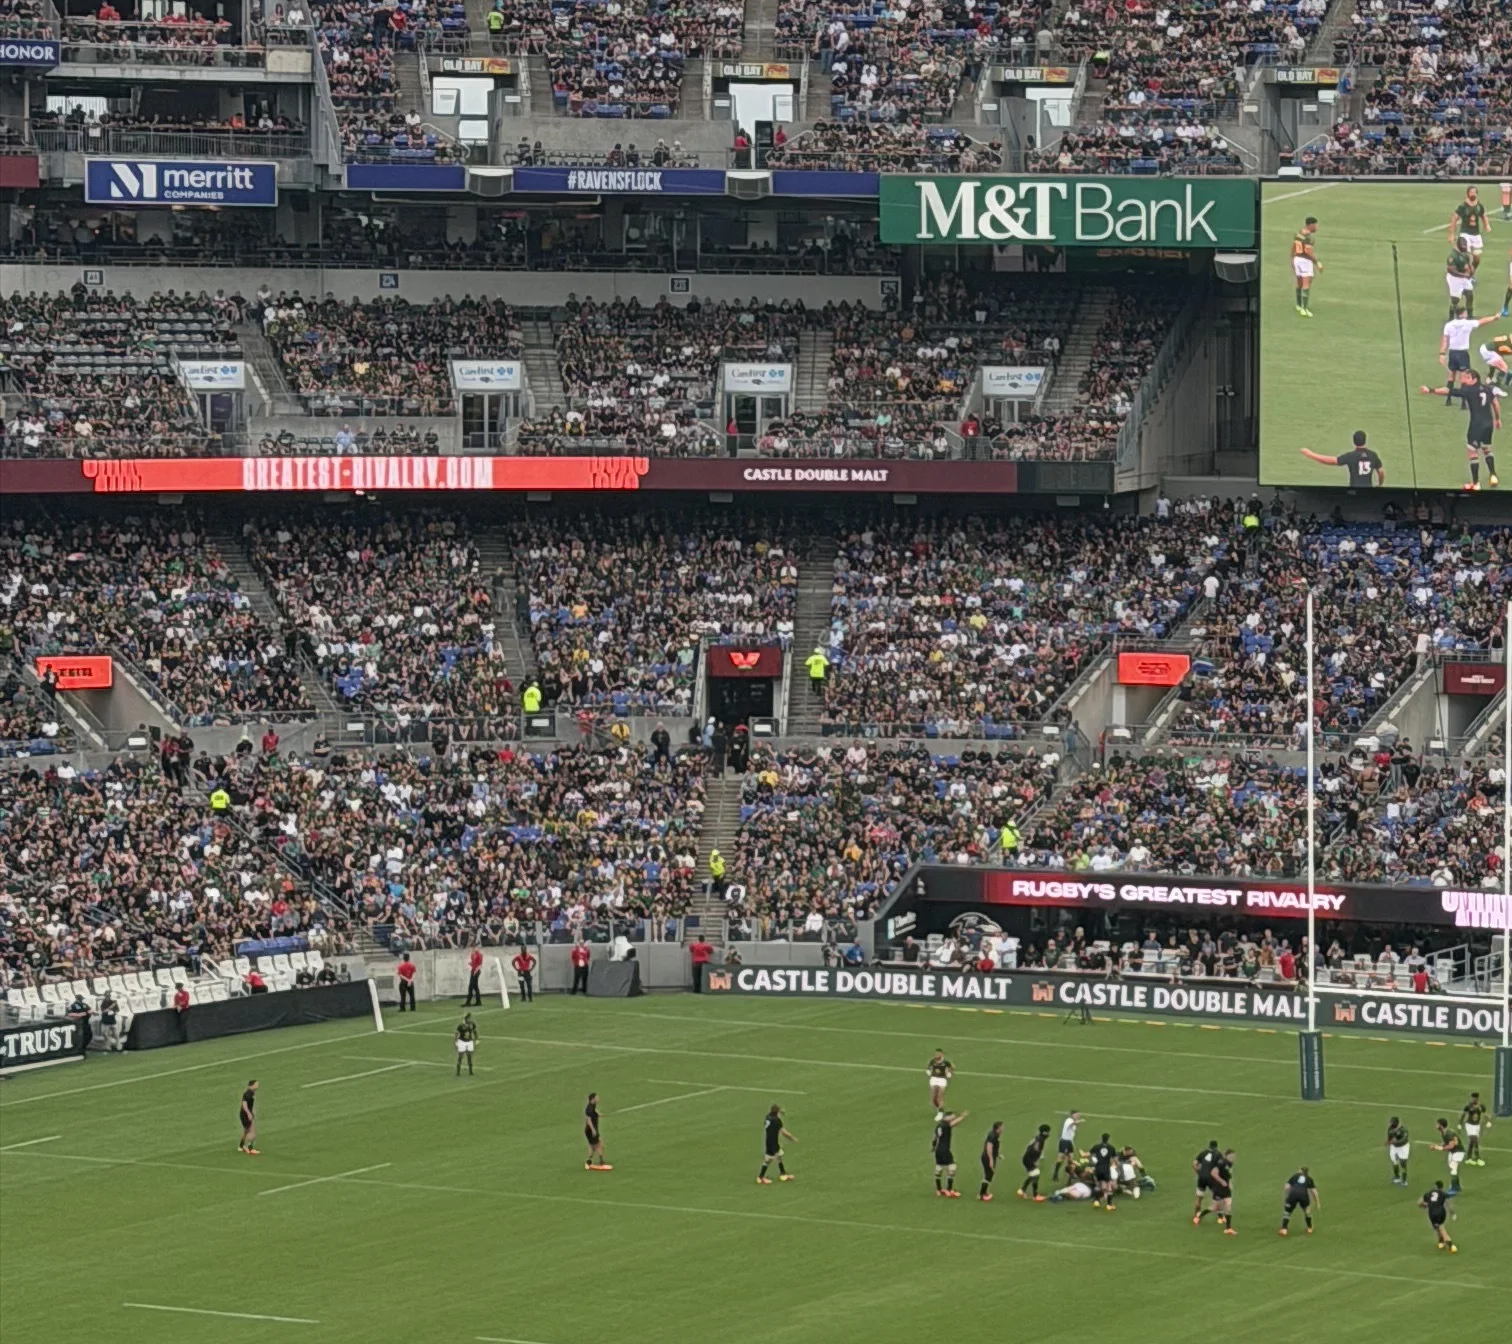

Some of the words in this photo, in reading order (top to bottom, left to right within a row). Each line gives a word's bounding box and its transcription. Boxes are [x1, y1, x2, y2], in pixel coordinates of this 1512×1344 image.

[163, 166, 253, 189] merritt
[567, 171, 662, 191] #RAVENSFLOCK
[164, 191, 224, 199] COMPANIES
[915, 181, 1067, 240] M&T
[1075, 183, 1218, 242] Bank
[243, 456, 493, 490] GREATEST-RIVALRY.COM
[743, 468, 792, 481] CASTLE
[795, 468, 848, 482] DOUBLE
[851, 468, 889, 482] MALT
[1358, 460, 1371, 475] 13
[1012, 880, 1116, 900] RUGBY'S
[1120, 885, 1242, 905] GREATEST
[1246, 890, 1346, 910] RIVALRY
[737, 969, 829, 992] CASTLE
[836, 971, 937, 996] DOUBLE
[941, 977, 1012, 1000] MALT
[1059, 981, 1147, 1007] CASTLE
[1153, 988, 1247, 1015] DOUBLE
[1360, 1001, 1449, 1029] CASTLE
